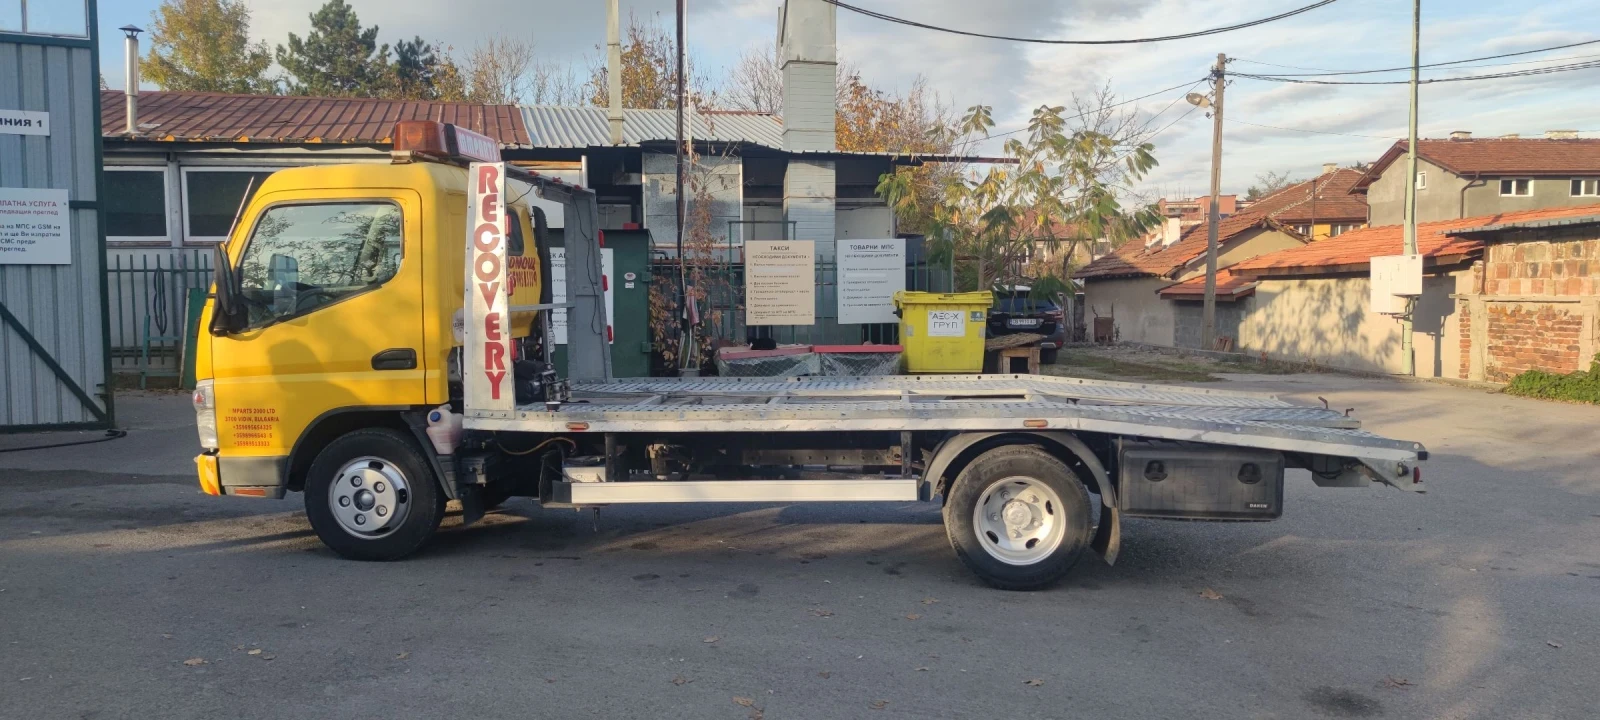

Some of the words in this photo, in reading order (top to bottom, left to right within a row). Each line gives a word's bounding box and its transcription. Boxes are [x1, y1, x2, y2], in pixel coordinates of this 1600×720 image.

[36, 119, 42, 128] 1
[28, 200, 57, 208] УСЛУГА
[473, 165, 507, 400] RECOVERY
[933, 321, 958, 329] ГРУП
